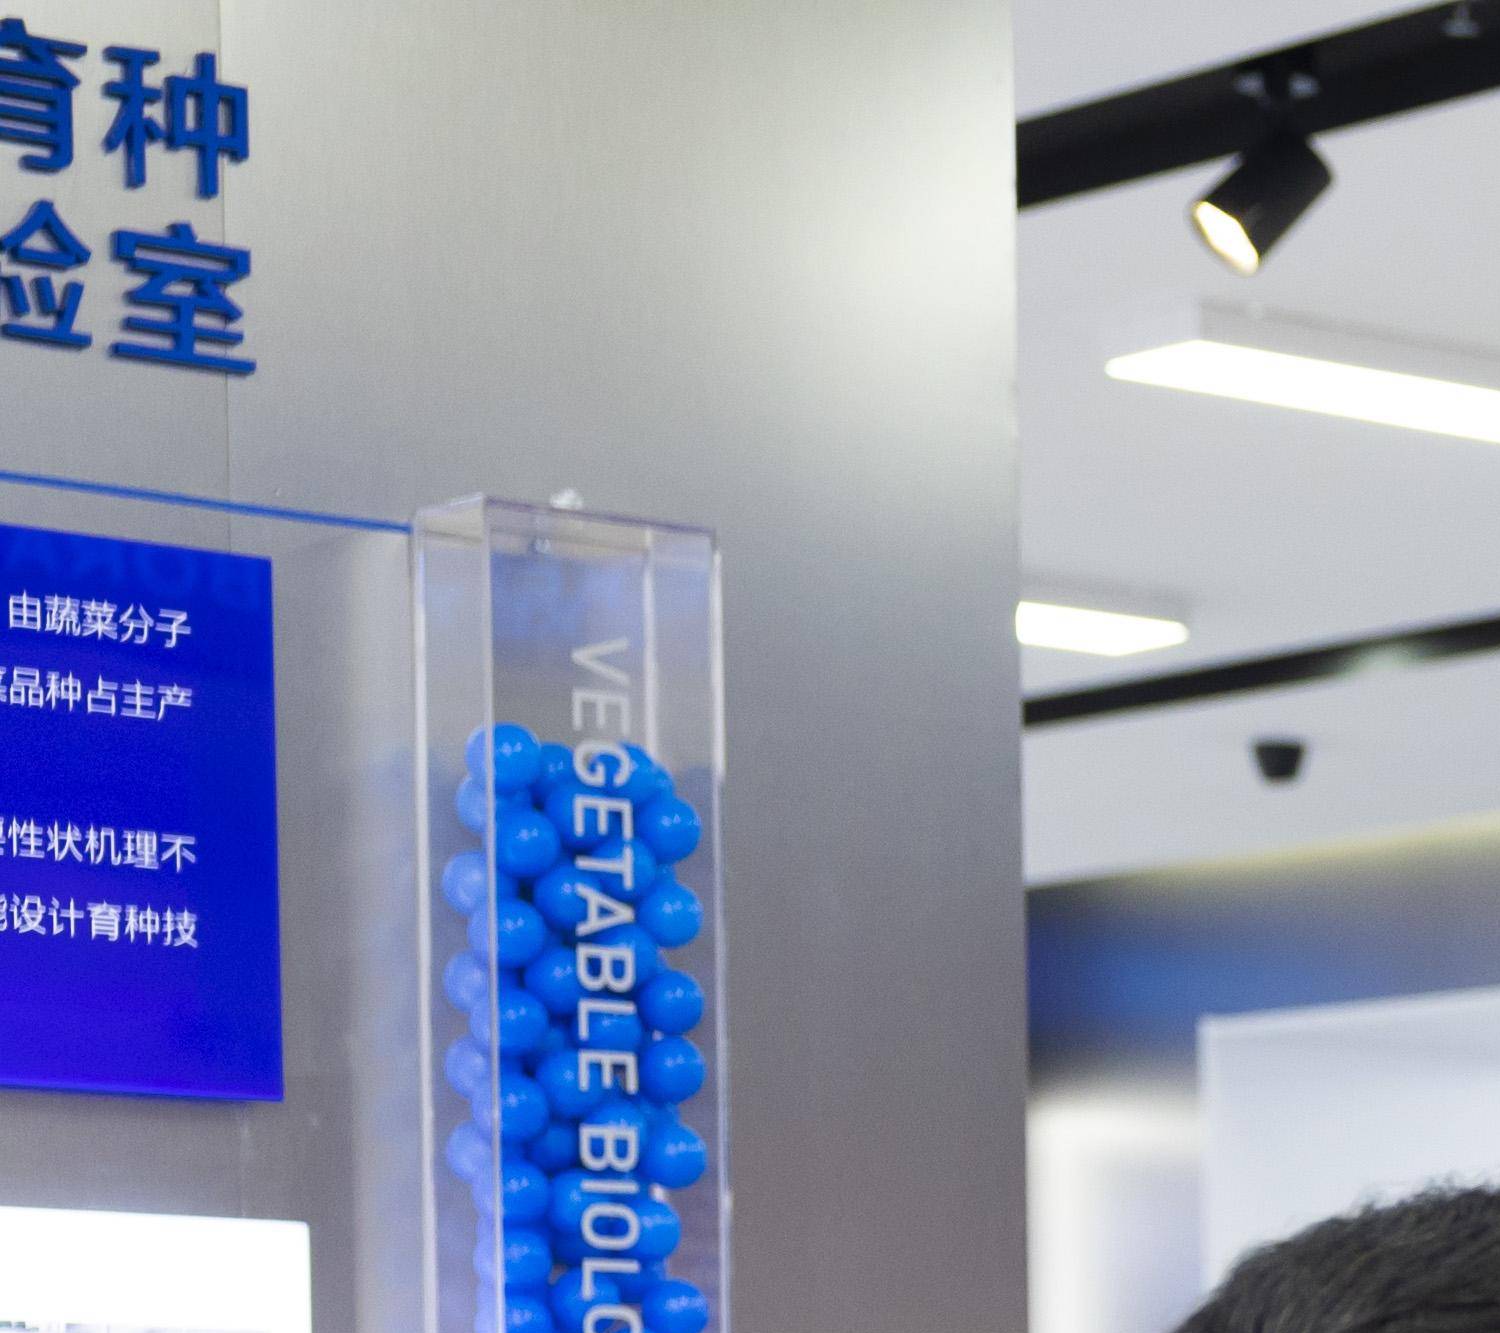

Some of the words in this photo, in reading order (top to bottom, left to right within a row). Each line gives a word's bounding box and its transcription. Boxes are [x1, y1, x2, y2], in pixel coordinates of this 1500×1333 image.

[8, 589, 192, 648] 由蔬菜分子
[0, 665, 193, 721] 品种占主产
[0, 814, 197, 872] 性状机理不
[570, 636, 640, 1097] VEGETABLE
[0, 892, 199, 948] 设计育种技
